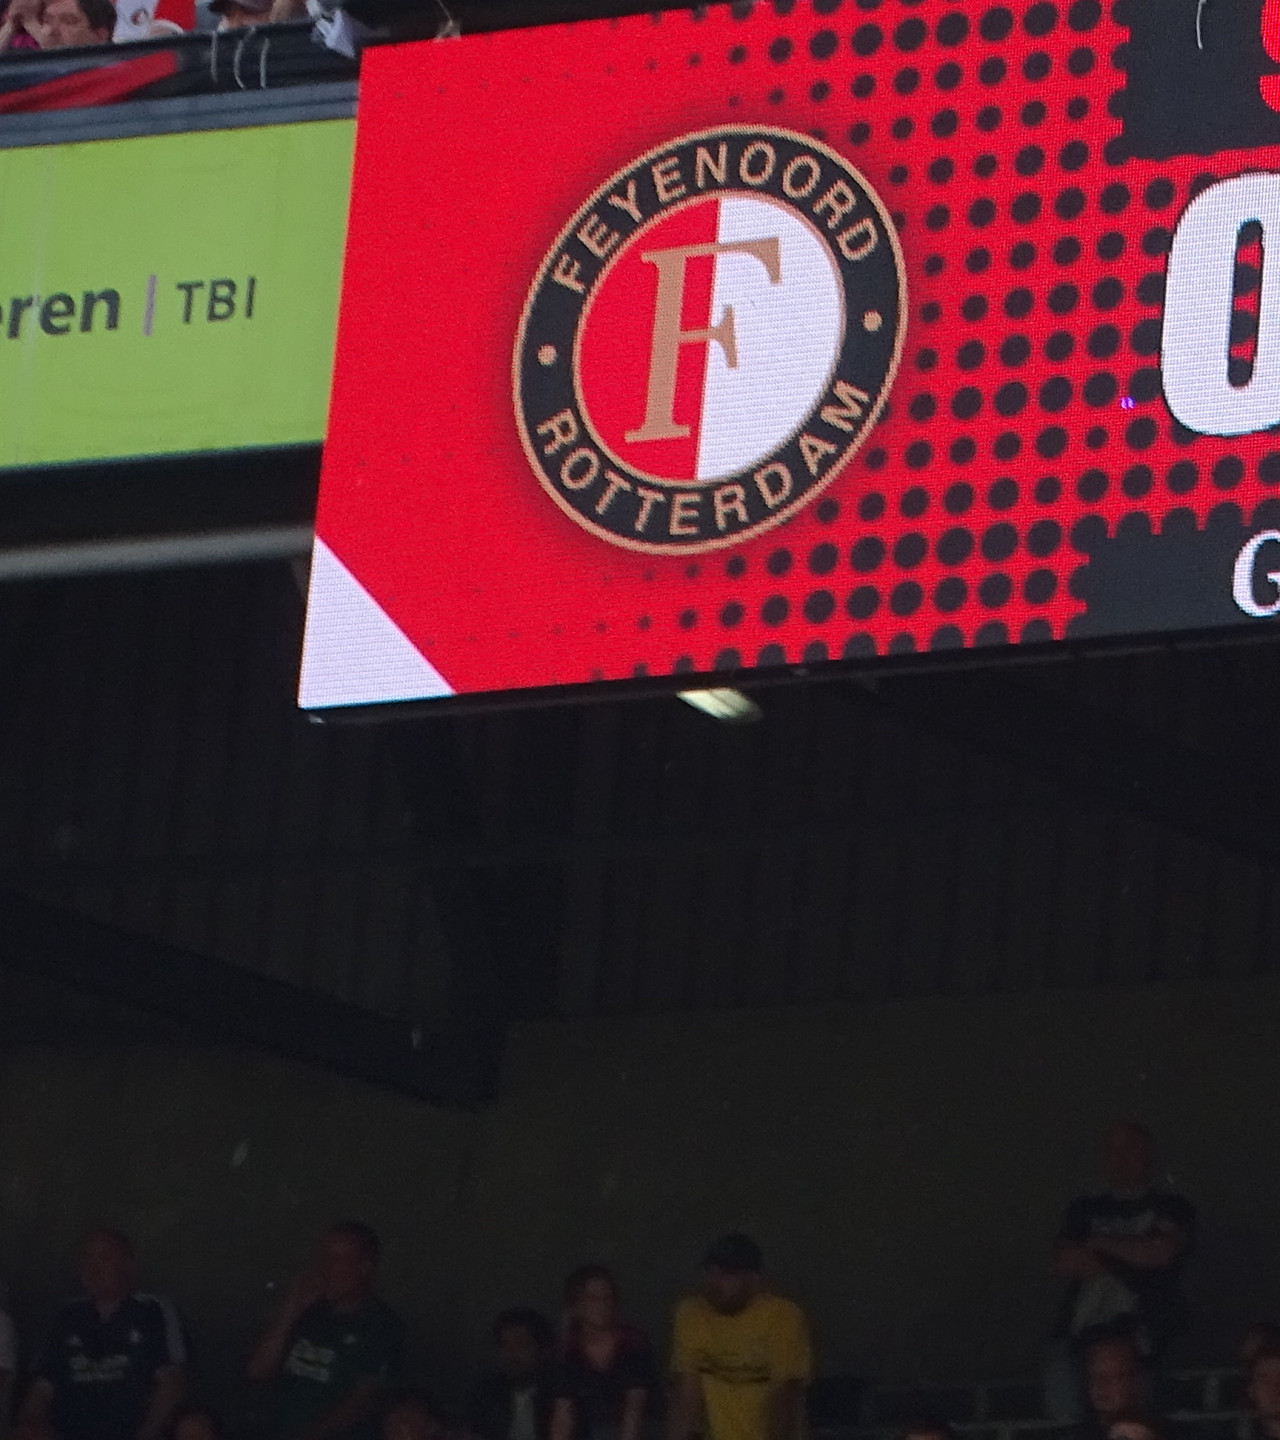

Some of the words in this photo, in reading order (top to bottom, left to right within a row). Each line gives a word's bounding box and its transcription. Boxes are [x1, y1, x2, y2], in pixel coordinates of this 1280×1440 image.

[554, 140, 879, 294] FEYENOORD
[0, 287, 121, 340] ren
[176, 274, 257, 324] TBI
[537, 379, 870, 536] ROTTERDAM
